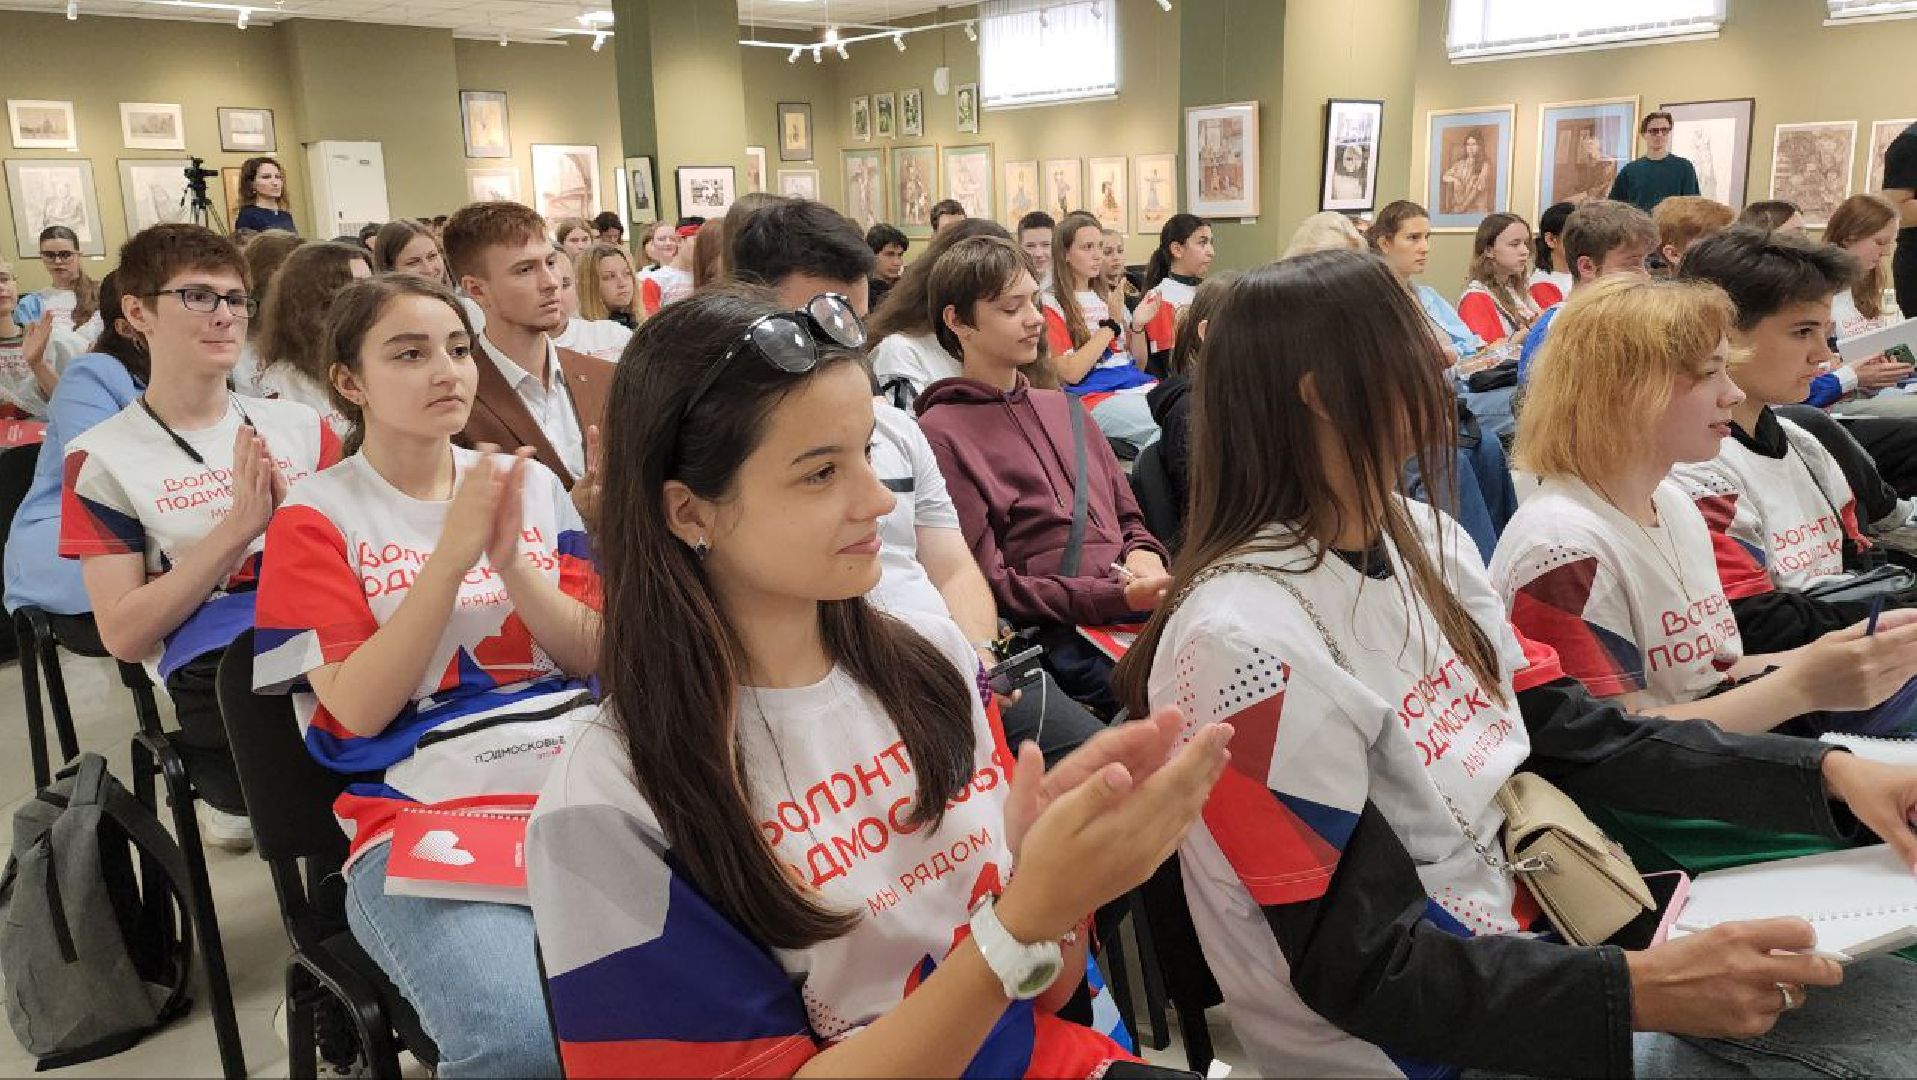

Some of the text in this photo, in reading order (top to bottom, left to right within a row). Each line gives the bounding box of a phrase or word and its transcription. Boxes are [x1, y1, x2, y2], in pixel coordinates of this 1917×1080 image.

[460, 588, 510, 609] РЯДО
[865, 826, 994, 917] МЫ РЯДОМ
